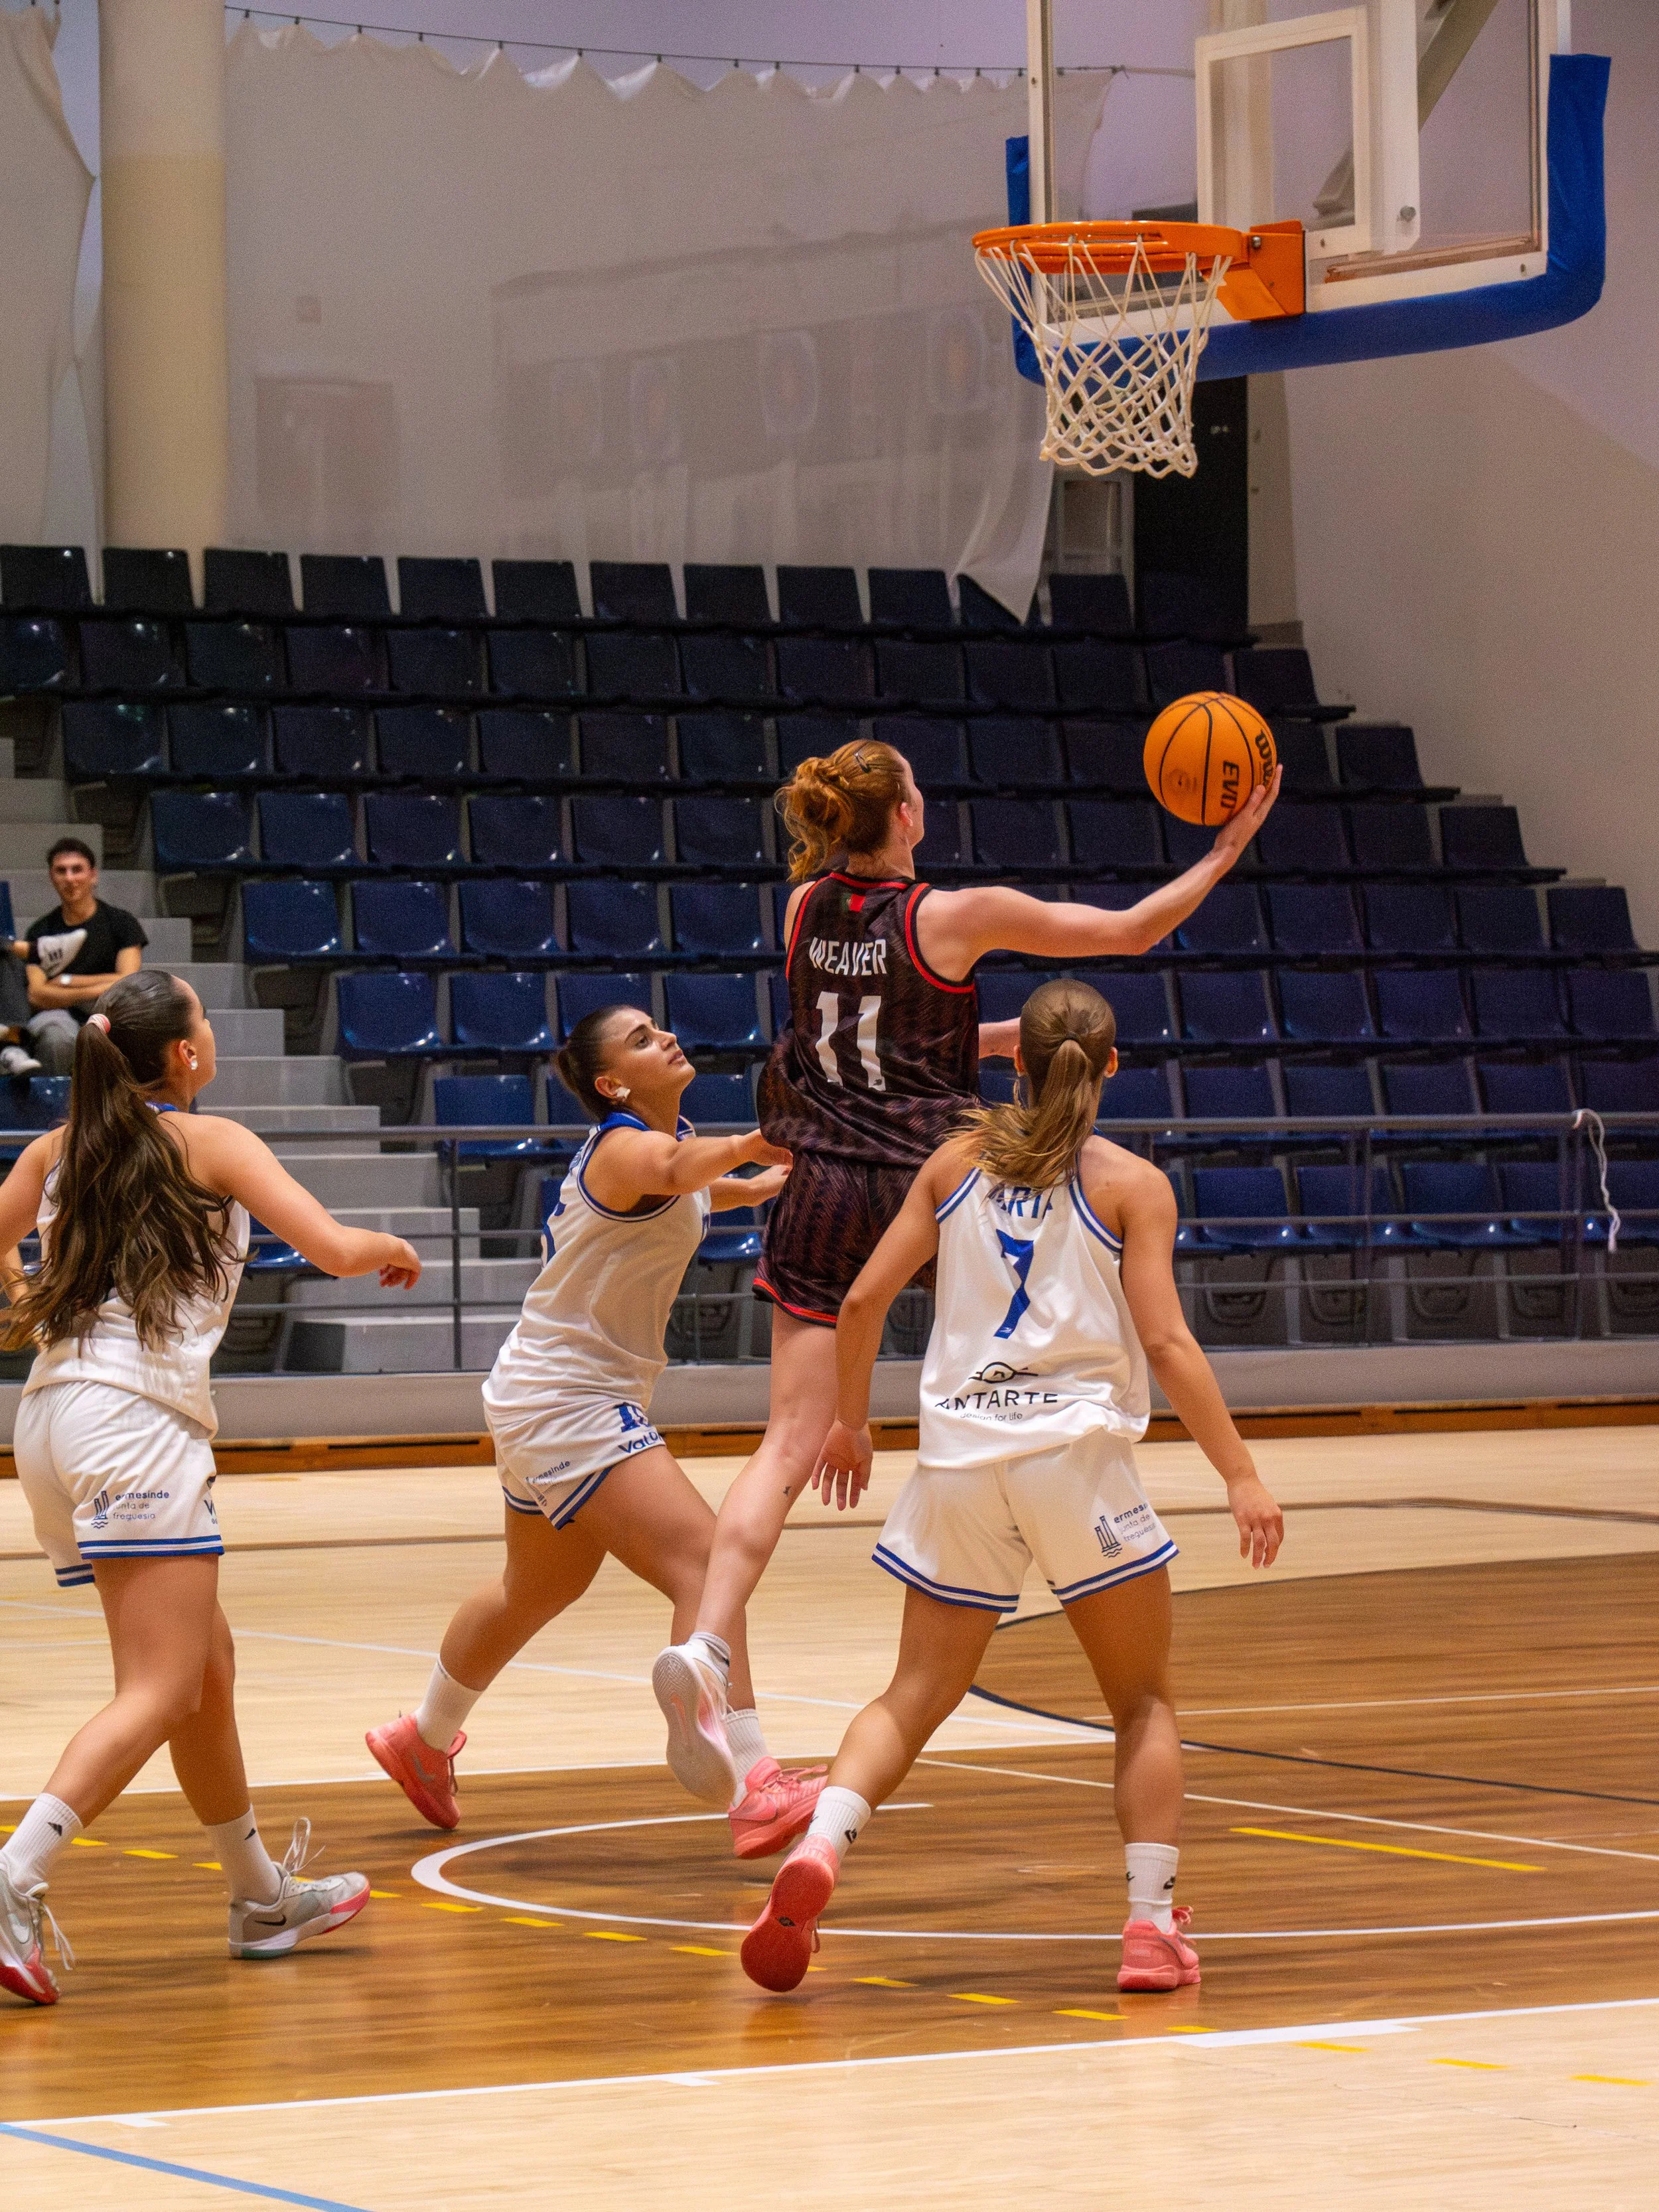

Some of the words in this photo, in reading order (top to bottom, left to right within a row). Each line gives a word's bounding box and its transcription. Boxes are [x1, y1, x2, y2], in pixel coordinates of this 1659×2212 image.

[809, 937, 887, 976] WEAVER
[816, 991, 887, 1091] 11
[993, 1229, 1035, 1340] 7
[935, 1389, 1058, 1411] ANTARTE
[1009, 1412, 1023, 1421] life
[113, 1512, 155, 1522] freguesia
[1139, 1513, 1150, 1523] de
